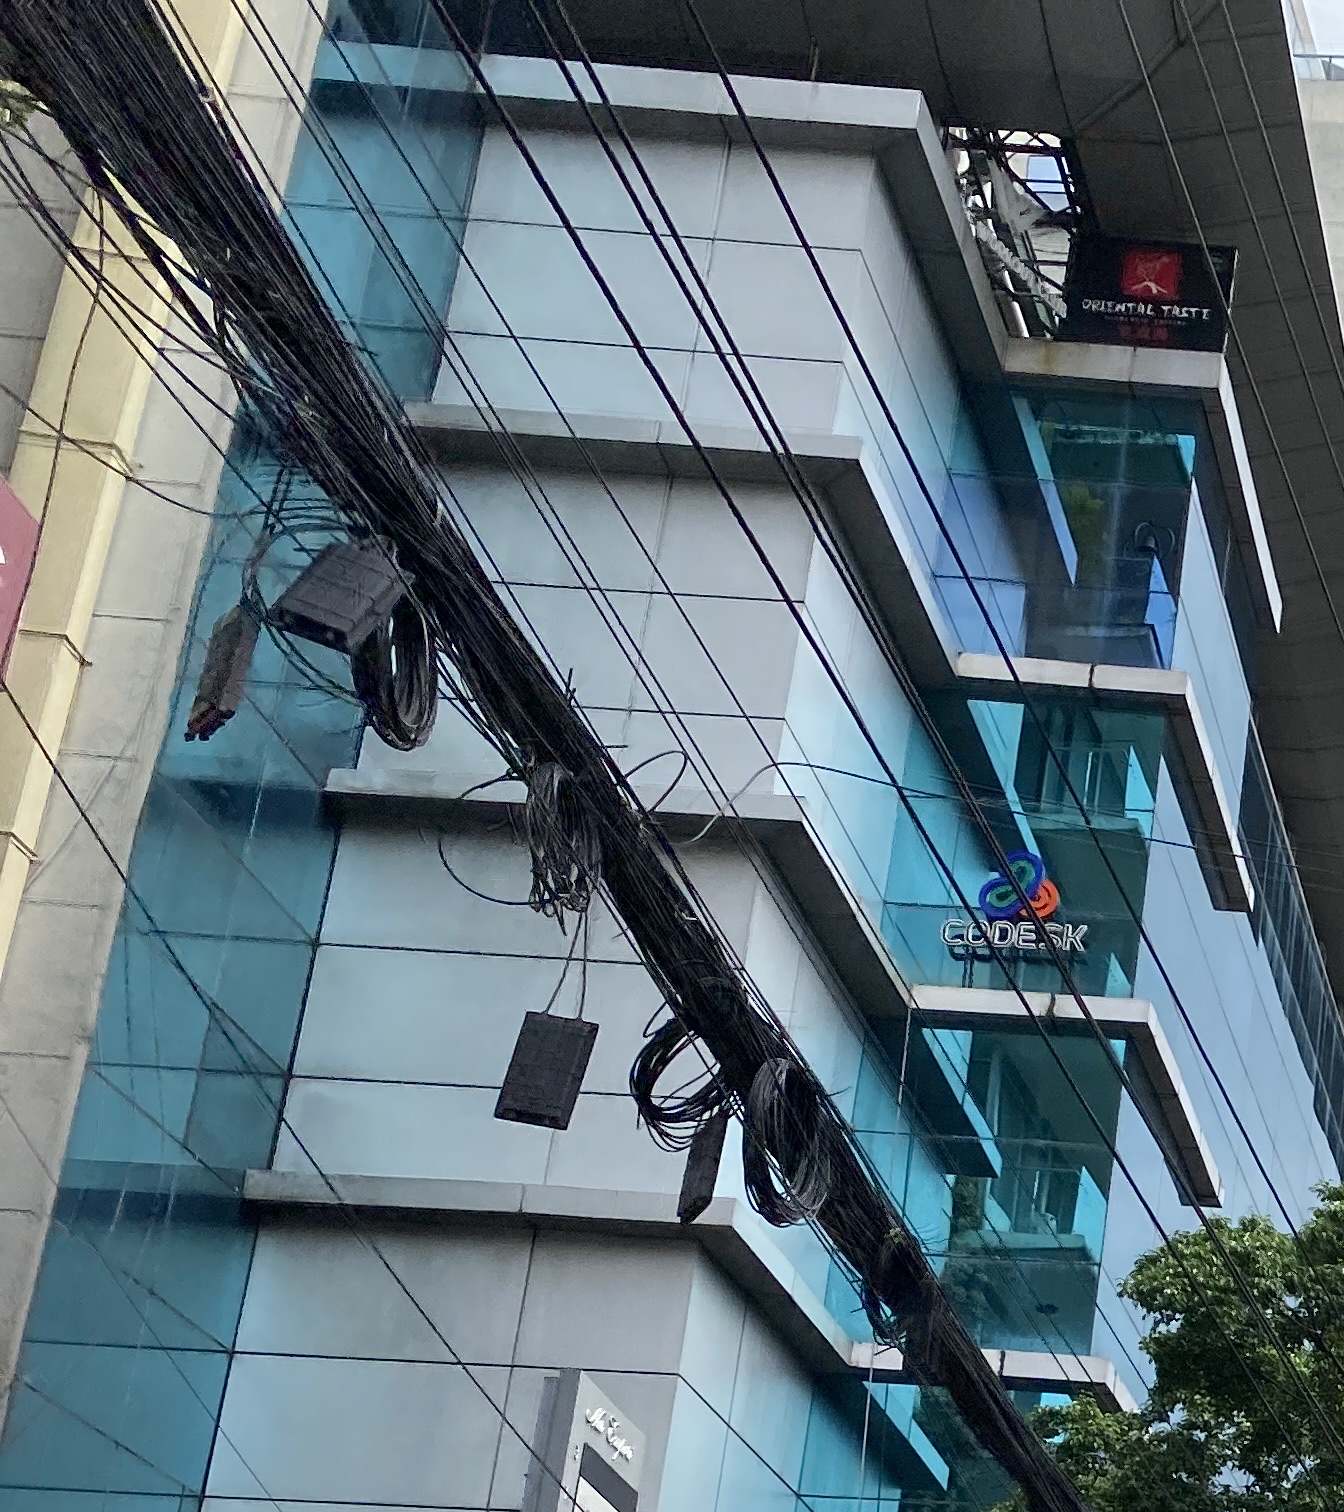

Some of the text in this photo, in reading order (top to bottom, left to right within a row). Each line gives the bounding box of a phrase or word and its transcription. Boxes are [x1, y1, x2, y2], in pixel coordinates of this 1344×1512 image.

[1081, 298, 1212, 320] ORIENTAL TASTE
[940, 918, 1088, 953] CODESK
